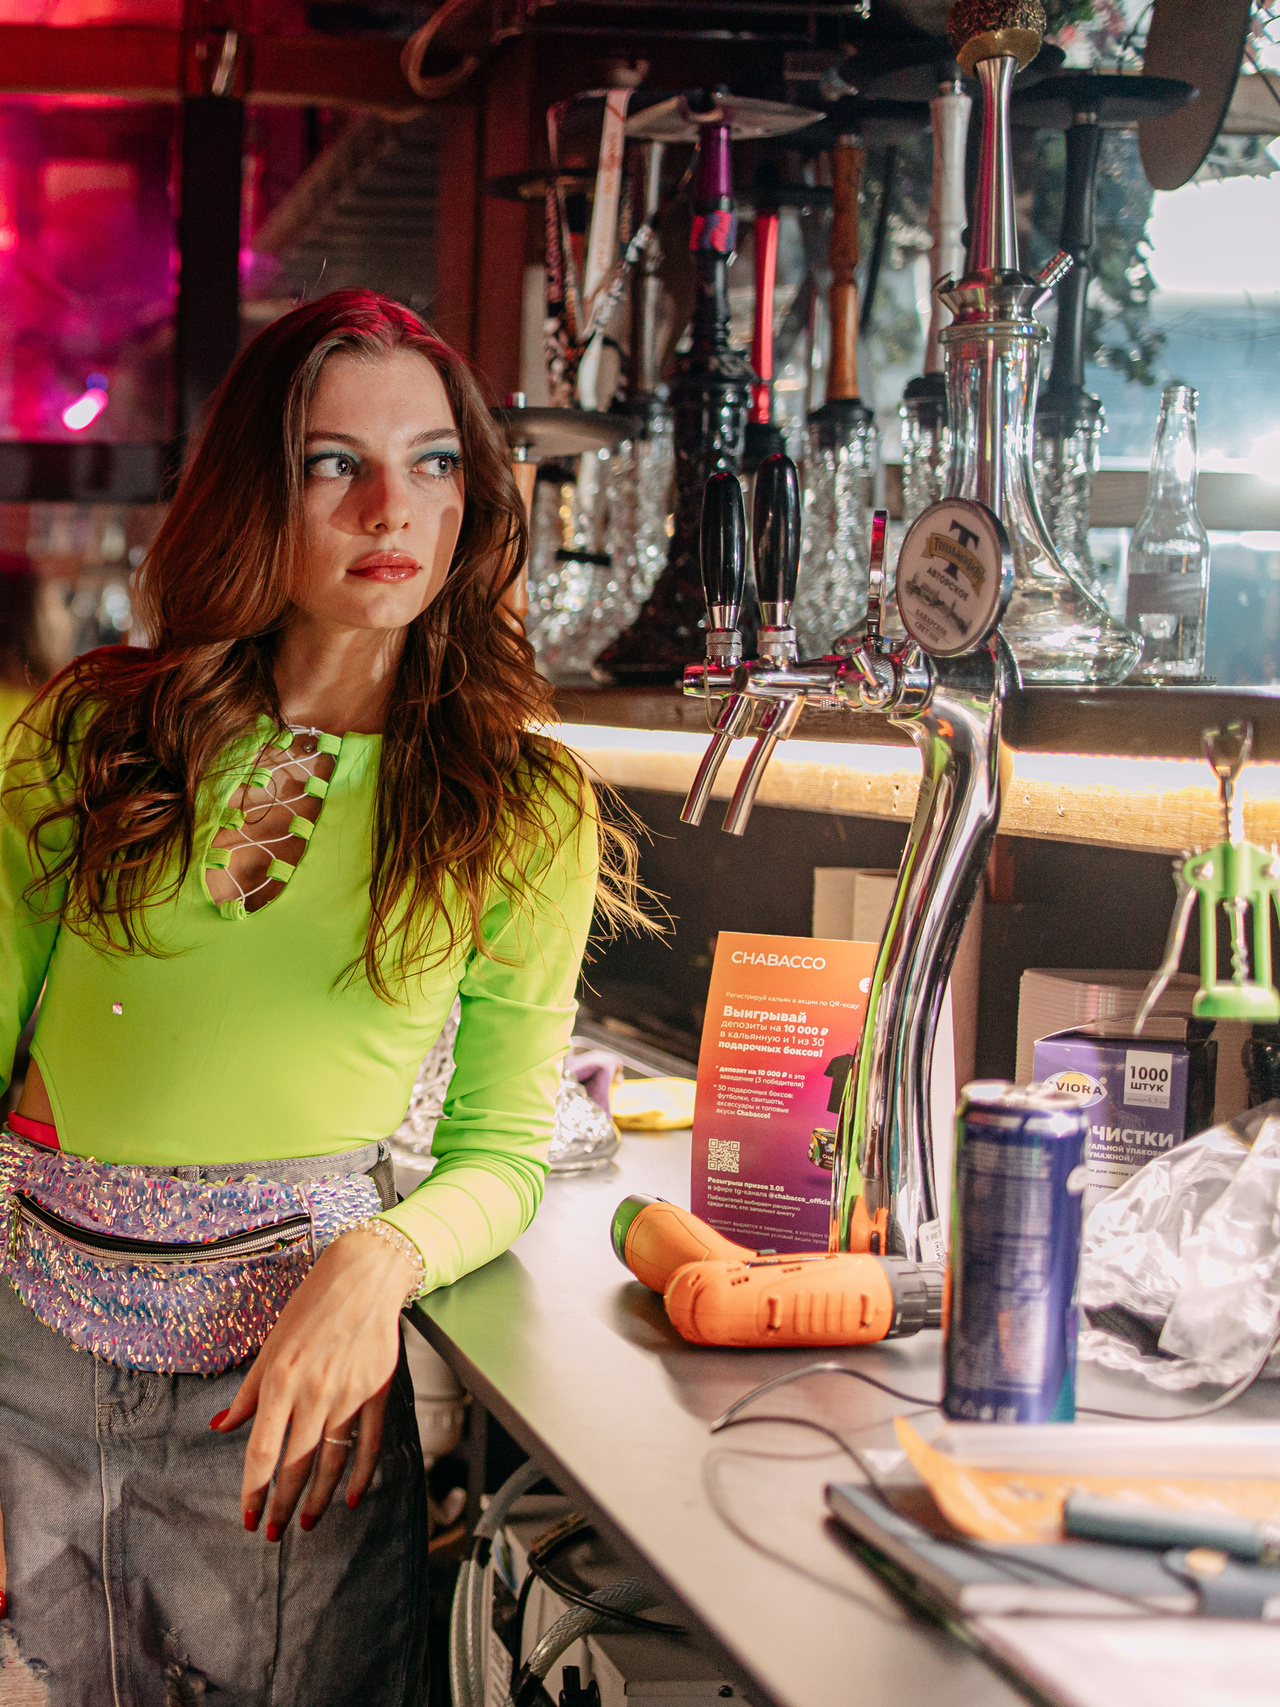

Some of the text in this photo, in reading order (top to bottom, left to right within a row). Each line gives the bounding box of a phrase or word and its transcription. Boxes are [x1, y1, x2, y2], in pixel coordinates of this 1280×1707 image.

[926, 566, 968, 601] АВТОРСКОЕ
[731, 951, 827, 970] CHABACCO
[726, 992, 766, 1002] Регистрируй
[829, 1000, 861, 1010] QR-коду:
[723, 1006, 807, 1024] Выигрывай
[720, 1020, 768, 1031] депозиты
[784, 1024, 795, 1033] 10
[797, 1026, 819, 1036] 000
[728, 1031, 780, 1044] кальянную
[792, 1036, 796, 1044] 1
[798, 1038, 809, 1046] из
[812, 1038, 825, 1047] 30
[718, 1041, 823, 1058] подарочных боксов!
[719, 1066, 747, 1074] депозит
[766, 1070, 781, 1078] 000
[1130, 1066, 1168, 1082] 1000
[720, 1074, 754, 1083] заведение
[762, 1078, 804, 1089] победителя)
[1130, 1082, 1164, 1092] ШТУК
[717, 1084, 794, 1099] 30 подарочных боксов:
[716, 1100, 754, 1110] аксессуары
[717, 1093, 785, 1106] футболки, свитшоты,
[716, 1108, 771, 1119] вкусы Chabacco!
[708, 1176, 784, 1192] Розыгрыш призов 3.05
[707, 1194, 744, 1204] Победителей
[712, 1186, 733, 1194] эфире
[734, 1188, 768, 1198] tg-канала
[707, 1200, 724, 1208] среди
